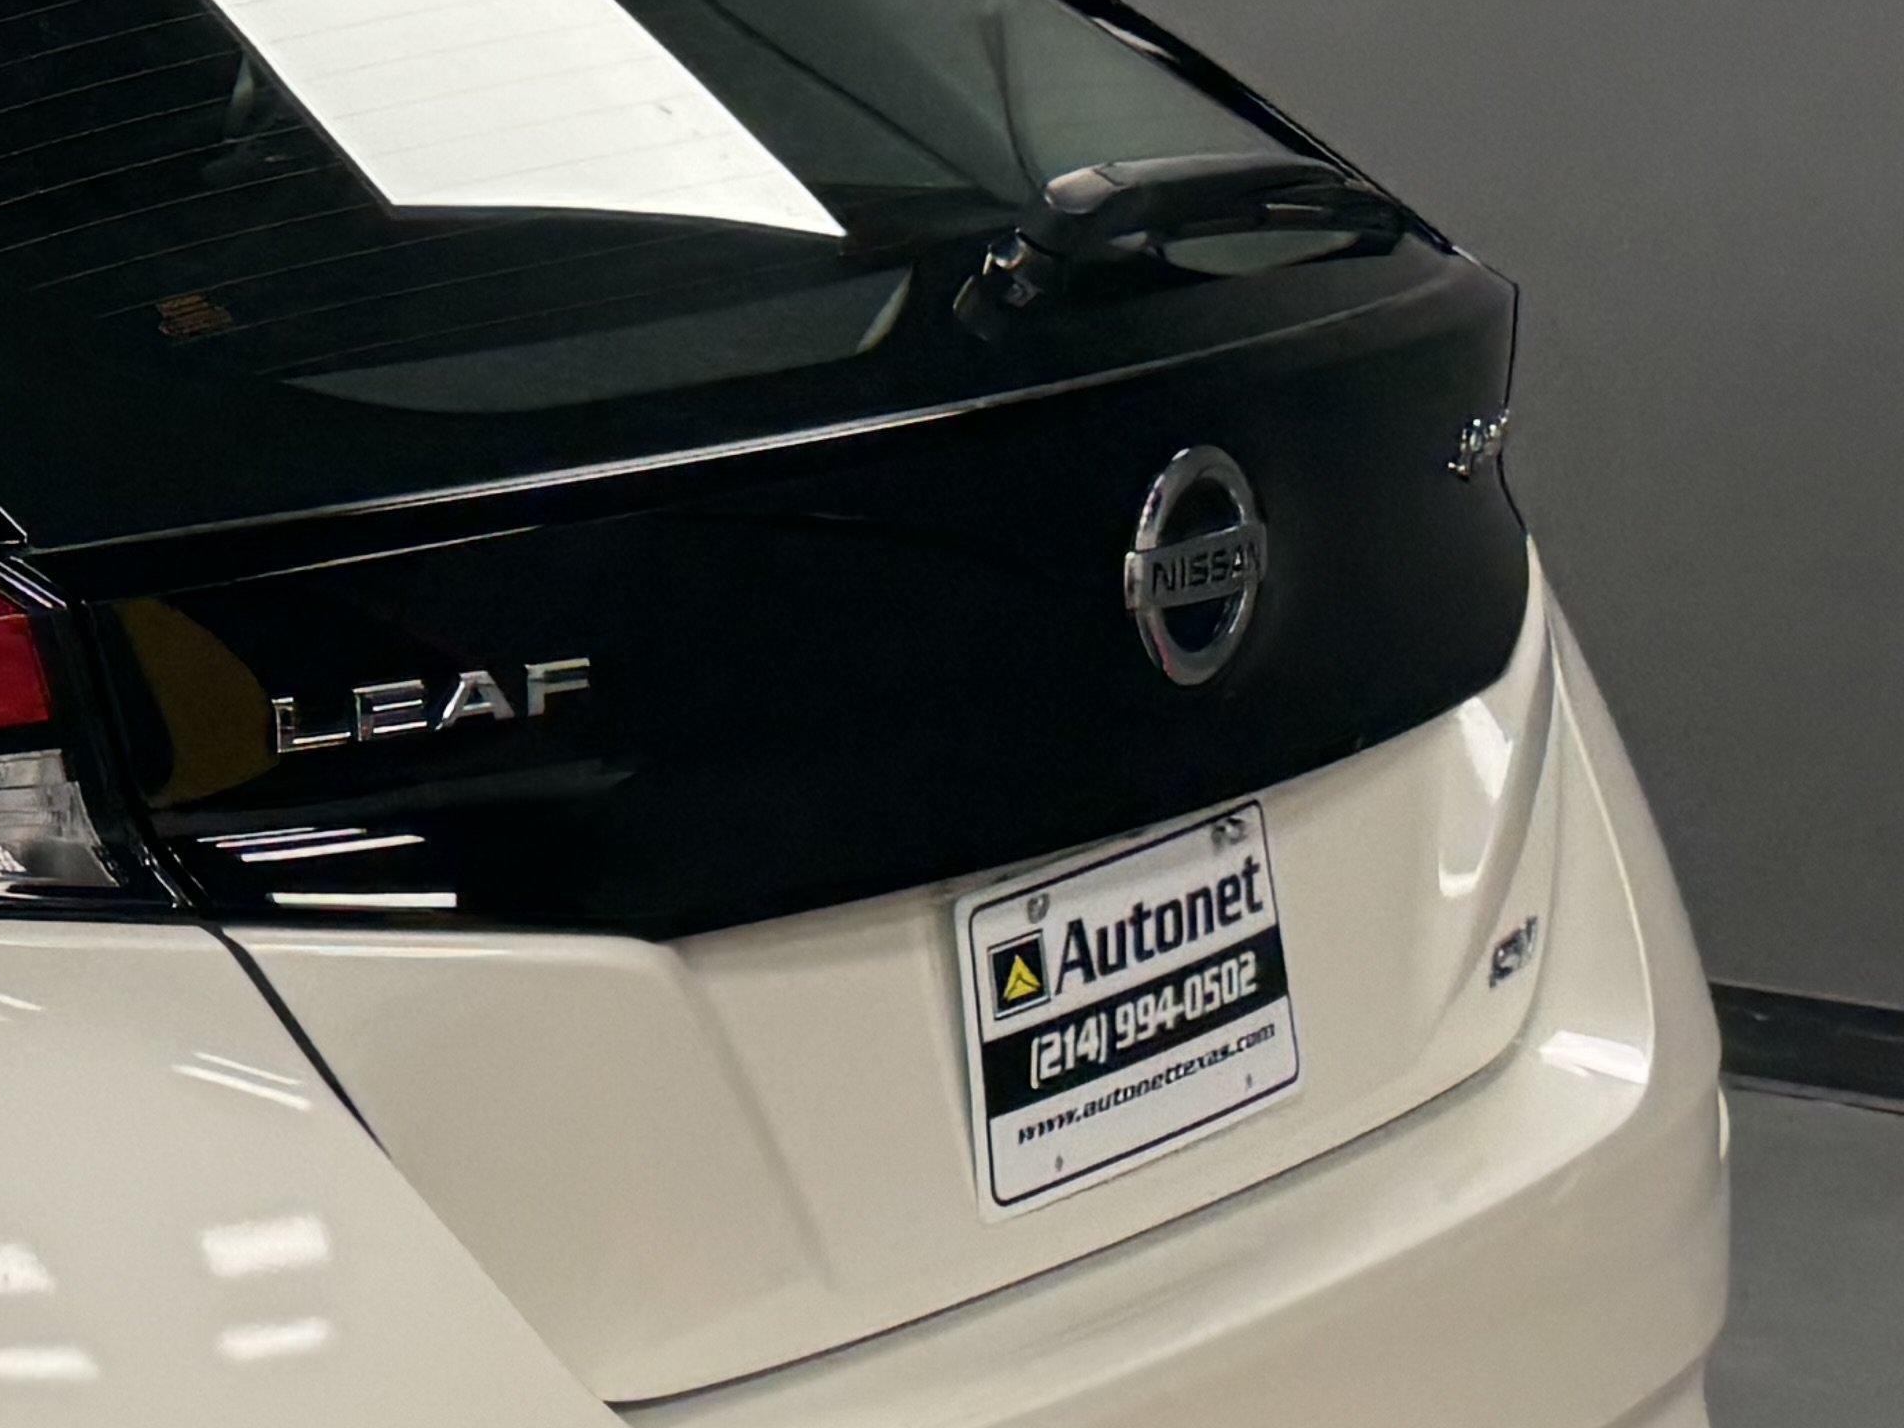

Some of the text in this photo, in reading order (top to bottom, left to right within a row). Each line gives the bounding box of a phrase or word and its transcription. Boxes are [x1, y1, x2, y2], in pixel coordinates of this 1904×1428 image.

[1152, 542, 1261, 595] NISSAN
[272, 657, 591, 754] LEAF
[1055, 855, 1263, 995] Autonet
[1030, 950, 1258, 1089] (214) 994-0502
[1018, 1023, 1275, 1145] www.autonettexas.com
